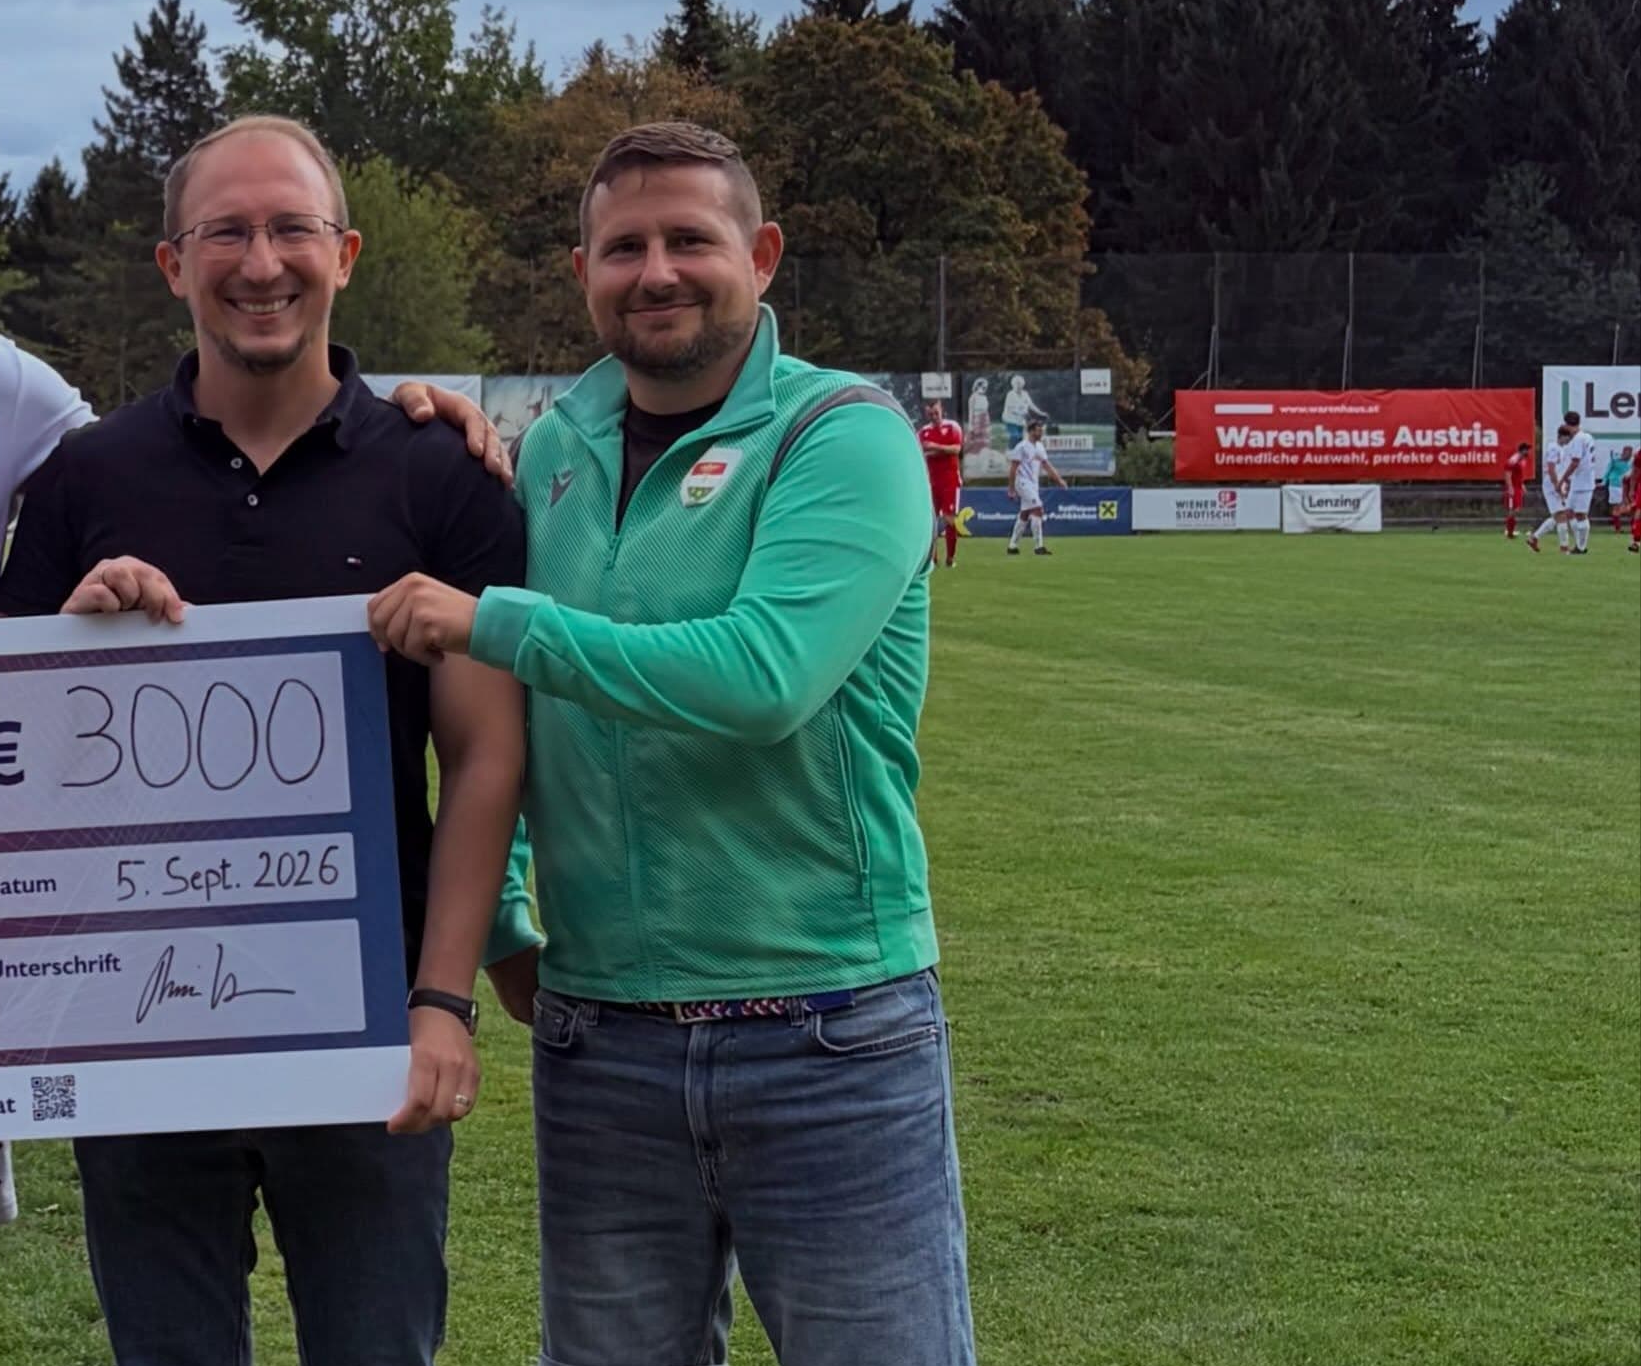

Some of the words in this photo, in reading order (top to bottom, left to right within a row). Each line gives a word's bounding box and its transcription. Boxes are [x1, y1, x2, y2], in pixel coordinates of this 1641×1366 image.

[1585, 381, 1641, 419] Le
[1215, 425, 1385, 448] Warenhaus
[1393, 422, 1499, 447] Austria
[1215, 452, 1299, 465] Unendliche
[1304, 452, 1369, 466] Auswahl,
[1373, 451, 1434, 467] perfekte
[1438, 451, 1497, 466] Qualität
[1176, 500, 1217, 509] WIENER
[1309, 494, 1360, 513] Lenzing
[61, 678, 325, 791] 3000
[116, 858, 150, 901] 5.
[162, 855, 241, 902] Sept.
[253, 845, 340, 890] 2026
